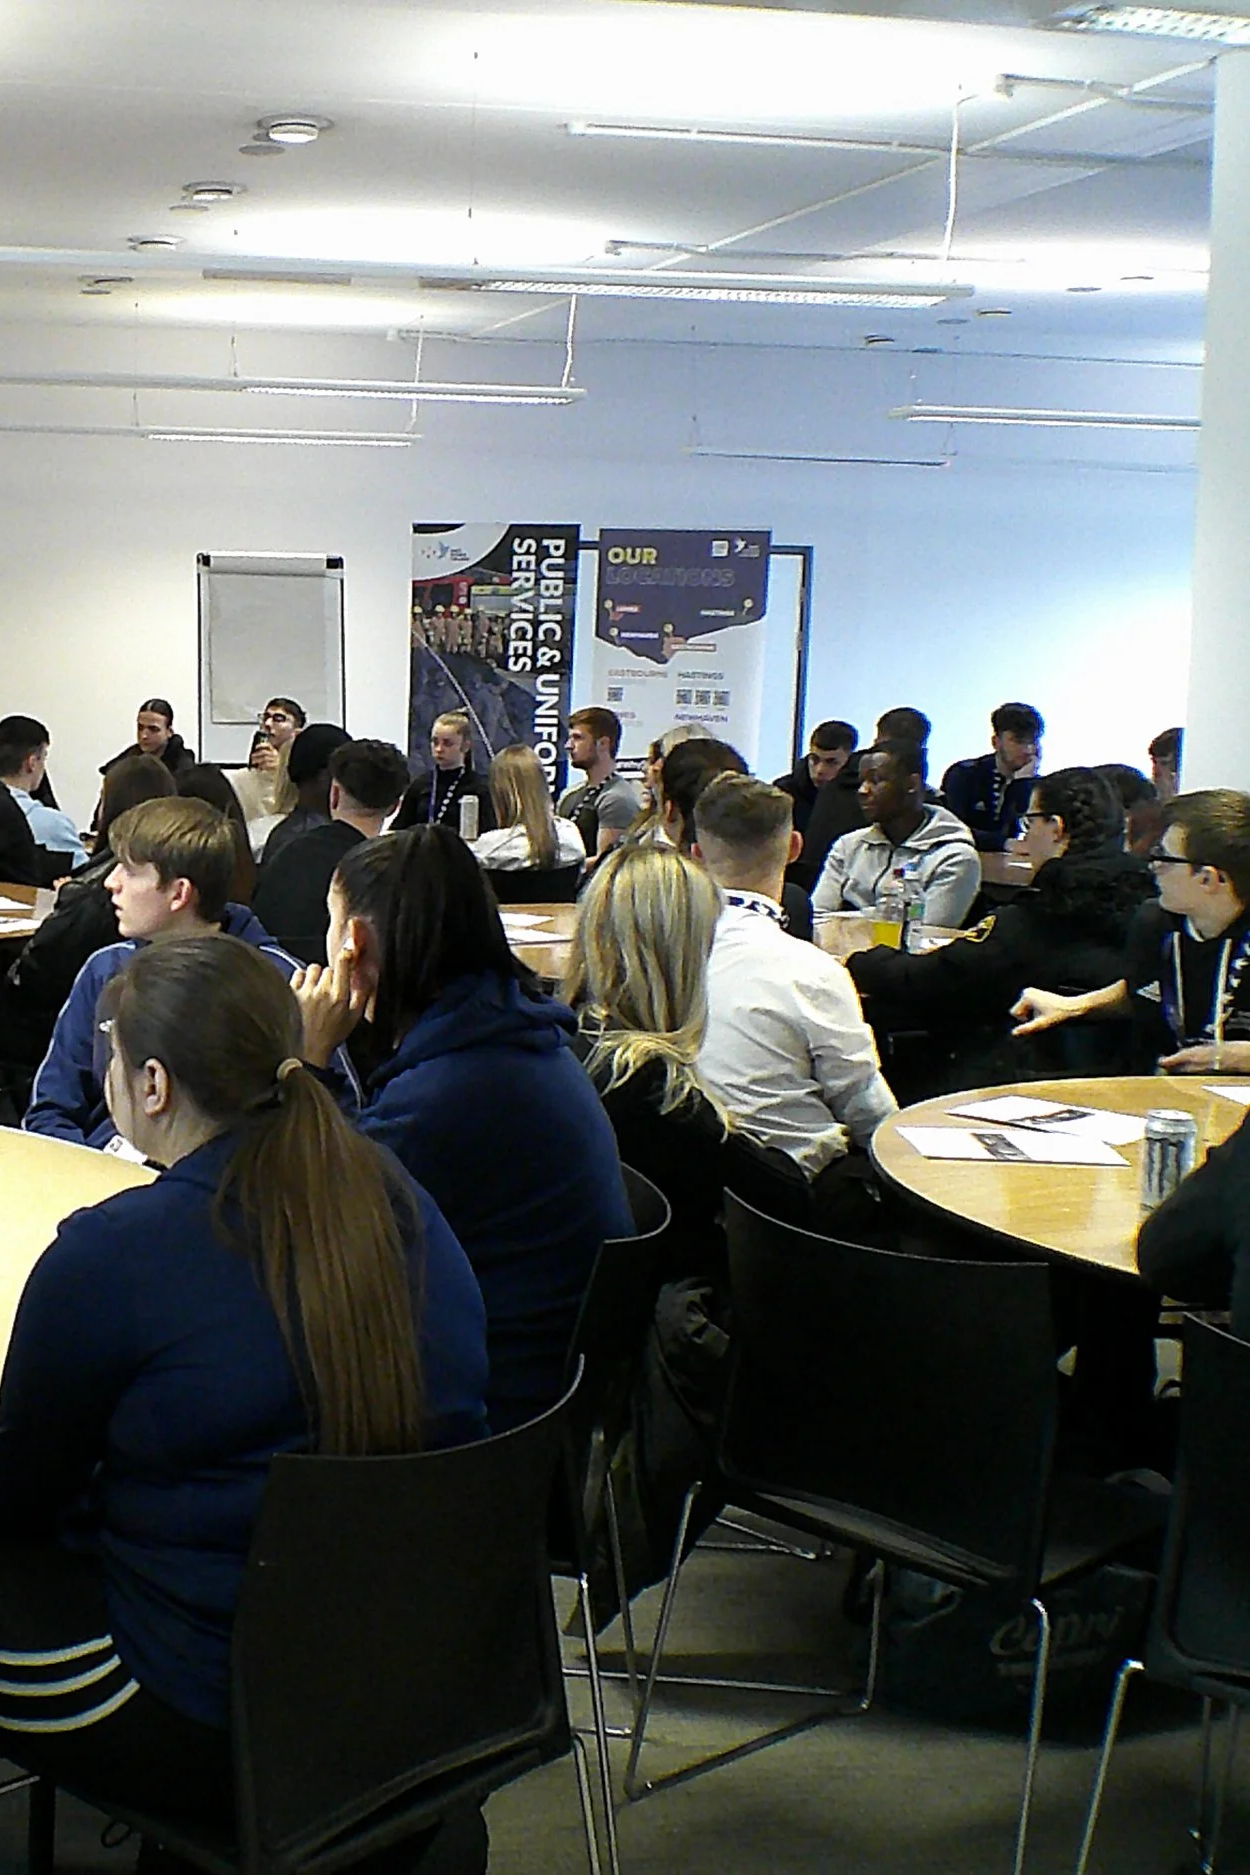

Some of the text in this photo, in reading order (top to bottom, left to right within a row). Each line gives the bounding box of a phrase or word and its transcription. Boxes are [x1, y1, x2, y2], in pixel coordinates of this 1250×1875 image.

[607, 547, 658, 565] OUR
[538, 538, 565, 641] PUBLIC
[508, 538, 537, 672] SERVICES
[536, 646, 561, 668] &
[678, 671, 724, 680] HASTINGS
[674, 713, 728, 722] NEWHAVEN
